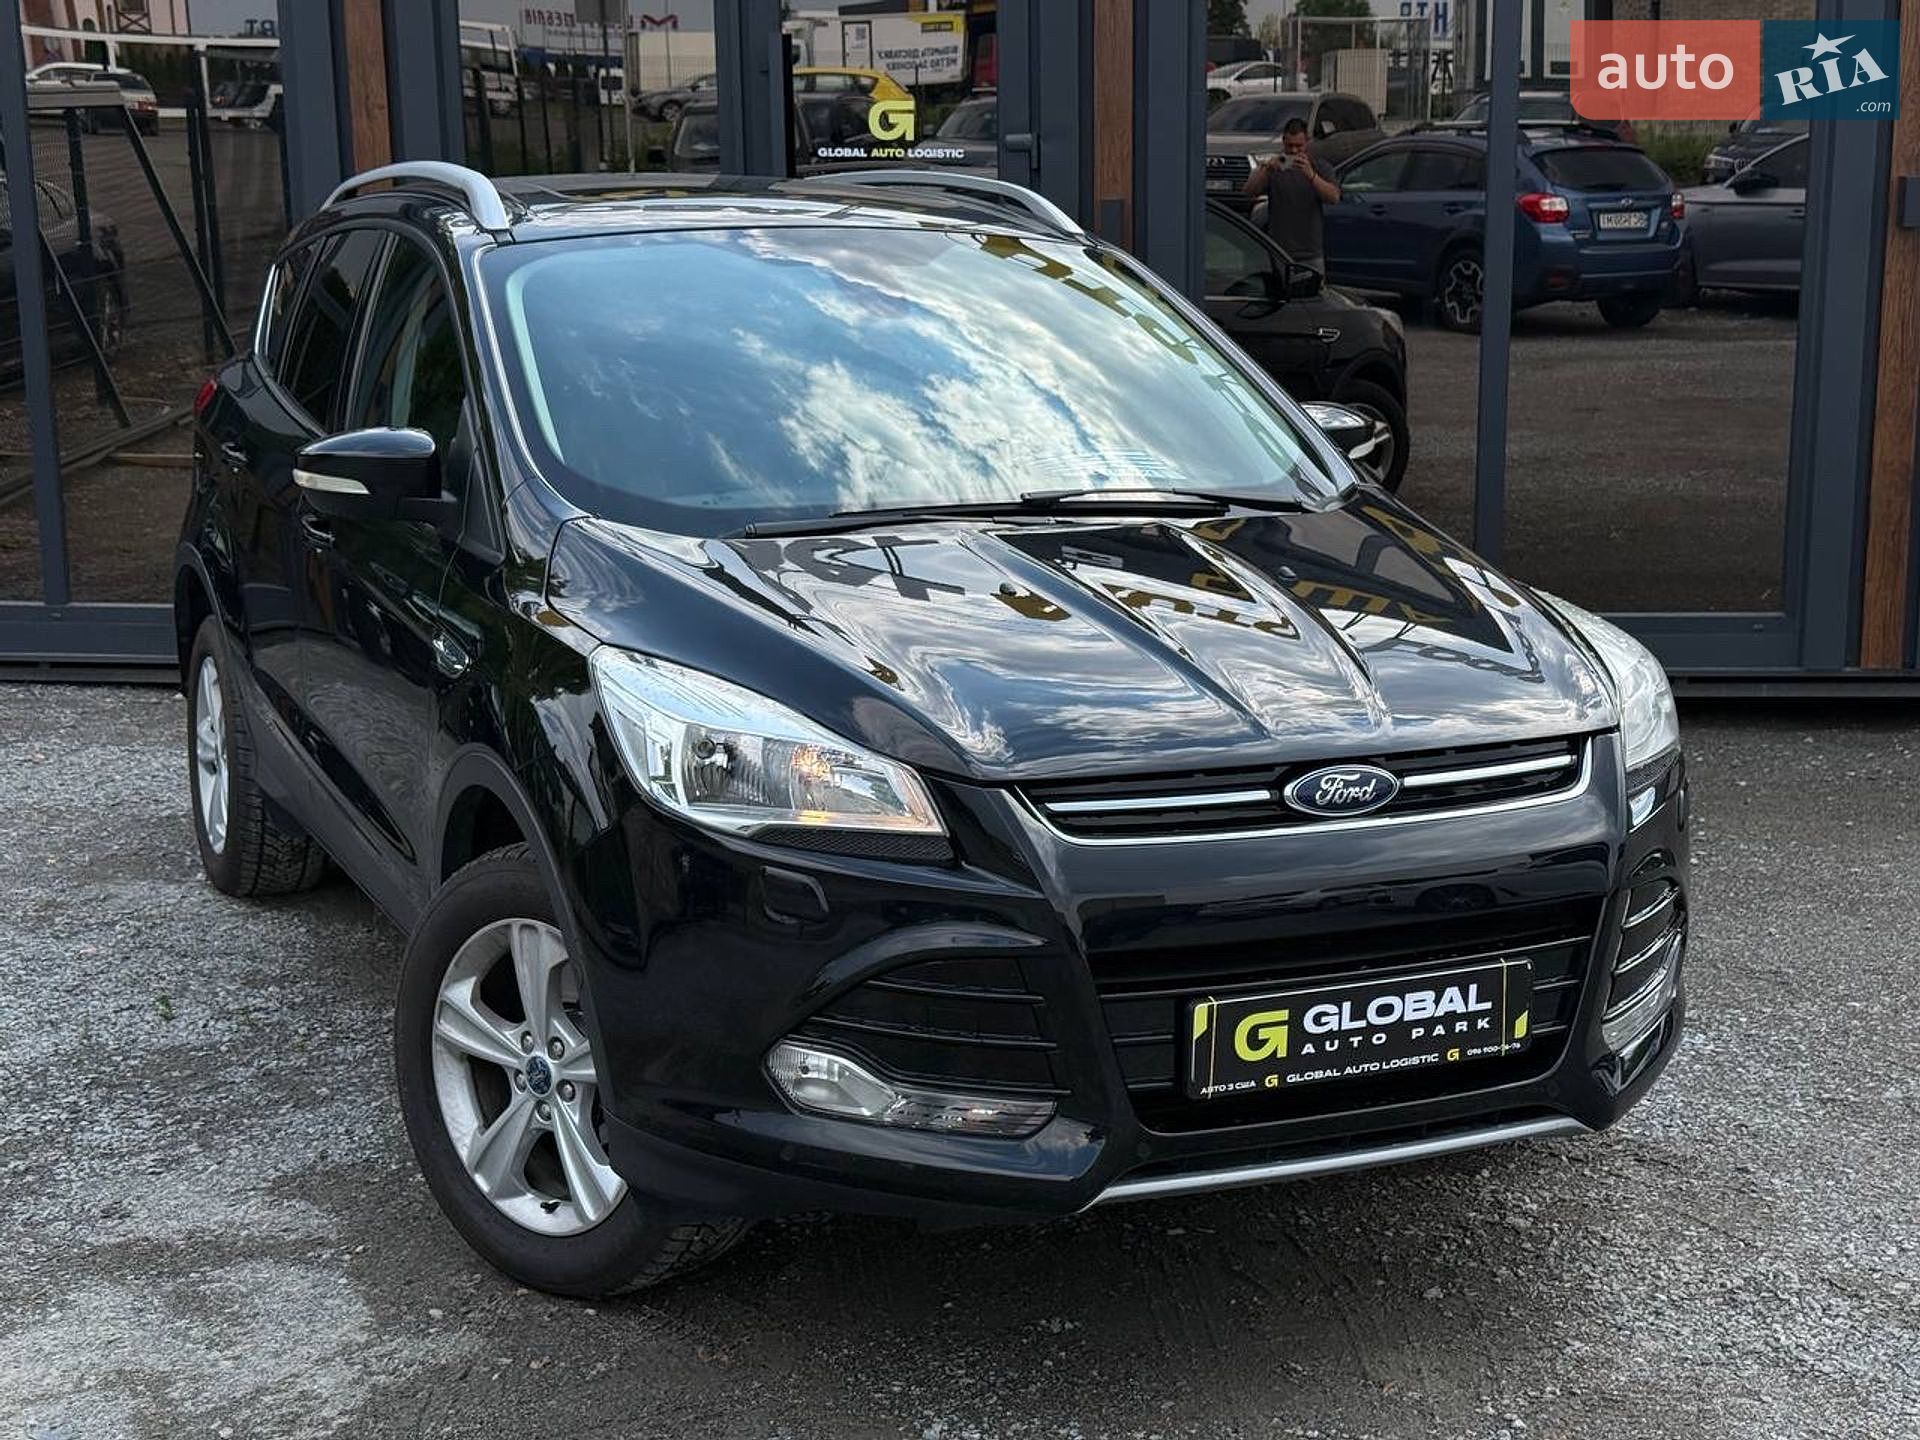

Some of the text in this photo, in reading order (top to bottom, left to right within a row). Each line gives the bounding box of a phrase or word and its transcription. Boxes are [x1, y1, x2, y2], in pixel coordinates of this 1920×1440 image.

[817, 147, 965, 158] GLOBAL AUTO LOGISTIC
[1315, 772, 1378, 807] Ford
[1303, 983, 1492, 1035] GLOBAL
[1301, 1017, 1491, 1055] AUTO PARK
[1286, 1068, 1342, 1083] GLOBAL
[1343, 1061, 1380, 1076] AUTO
[1381, 1053, 1440, 1070] LOGISTIC
